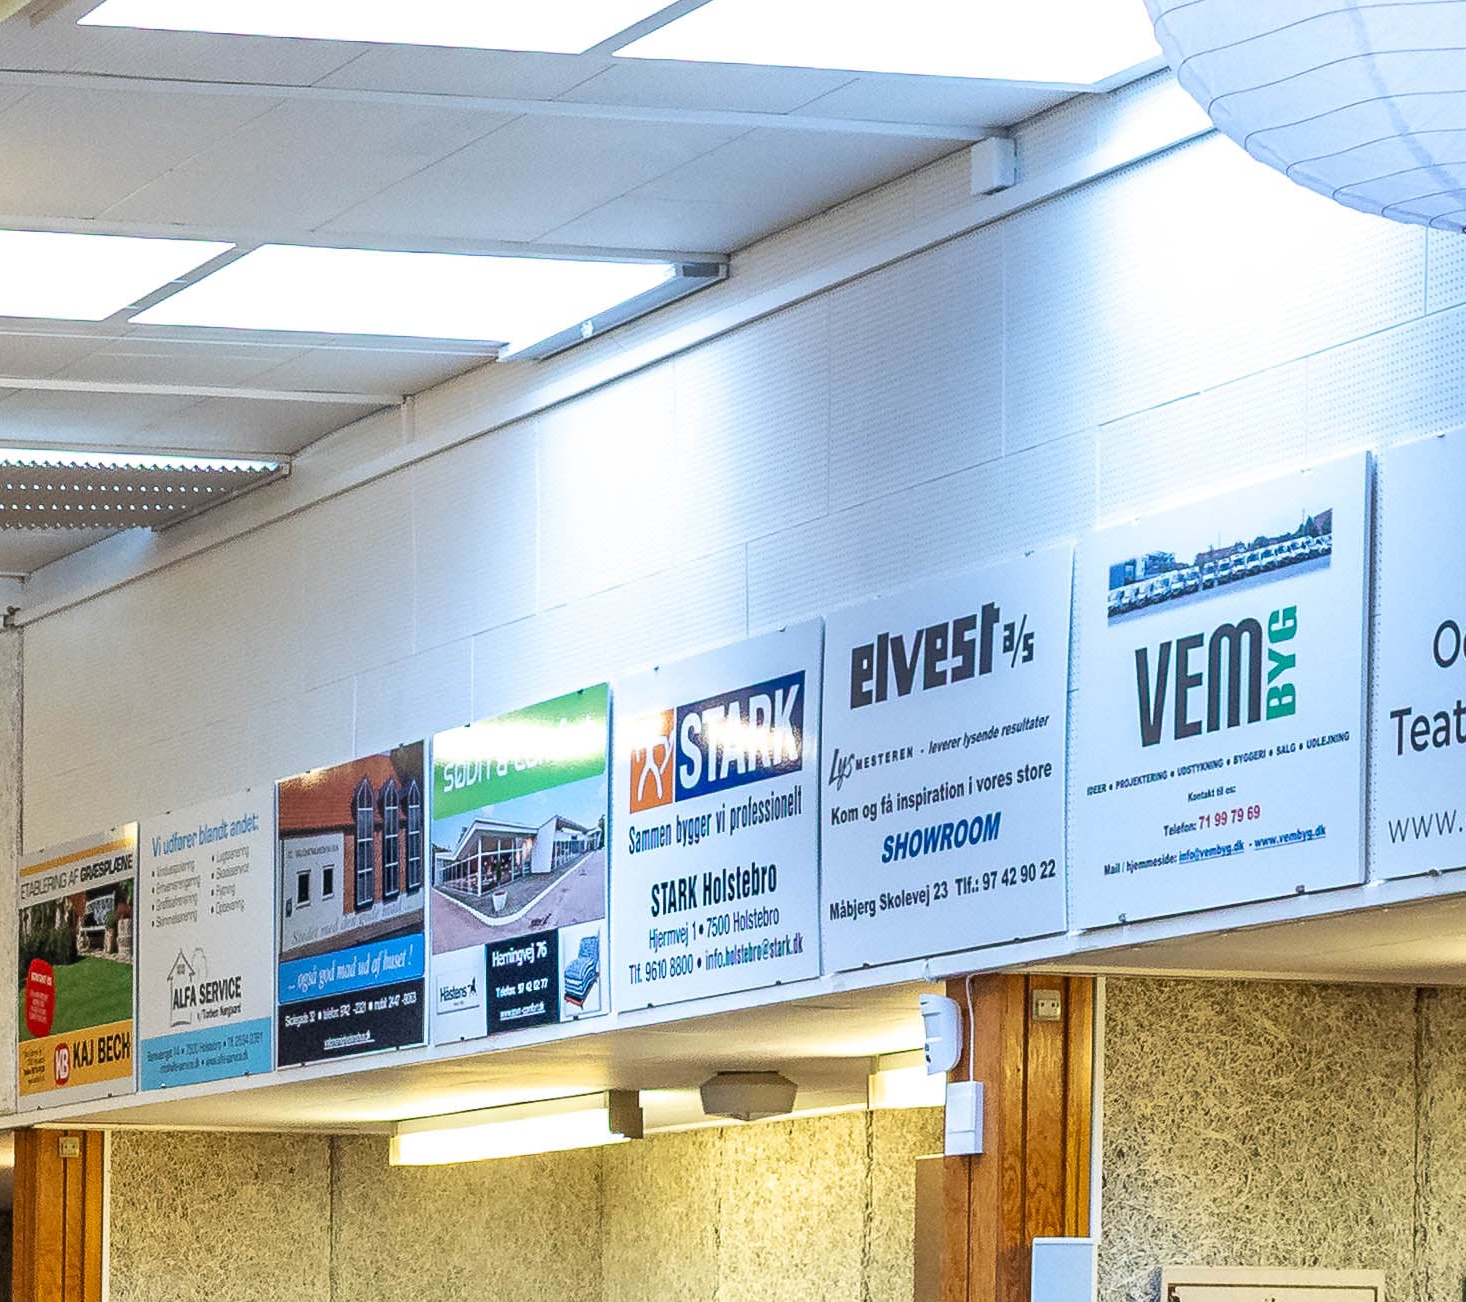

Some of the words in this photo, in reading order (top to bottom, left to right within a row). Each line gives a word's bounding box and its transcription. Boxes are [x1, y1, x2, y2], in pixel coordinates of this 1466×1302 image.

[850, 602, 1000, 709] elvest
[1002, 614, 1035, 668] a/s
[1266, 605, 1298, 720] BYG
[1135, 617, 1263, 747] VEM
[679, 684, 800, 790] STARK
[928, 736, 961, 755] leverer
[963, 726, 1000, 749] lysende
[1001, 715, 1049, 737] resultater
[1087, 783, 1107, 796] IDEER
[1115, 770, 1168, 790] PROJEKTERING
[1177, 758, 1224, 777] UDSTYKNING
[1233, 749, 1266, 765] BYGGERI
[1276, 742, 1296, 756] SALG
[1306, 731, 1350, 749] UDLEJNING
[629, 824, 671, 855] Sammen
[676, 811, 712, 847] bygger
[716, 803, 725, 833] vi
[730, 785, 802, 835] professionelt
[831, 807, 858, 826] Kom
[862, 803, 877, 821] og
[881, 793, 893, 815] få
[896, 782, 965, 812] inspiration
[976, 772, 1013, 793] vores
[1016, 762, 1053, 784] store
[1188, 789, 1215, 802] Kontakt
[152, 836, 161, 857] Vi
[198, 819, 228, 845] blandt
[881, 811, 1002, 864] SHOWROOM
[1163, 822, 1197, 837] Telefon:
[1198, 814, 1211, 830] 71
[1215, 811, 1228, 826] 99
[1231, 808, 1244, 823] 79
[1247, 805, 1261, 820] 69
[1104, 862, 1121, 876] Mail
[1126, 853, 1178, 874] hjemmeside:
[1254, 824, 1326, 851] www.vembyg.dk
[21, 872, 67, 899] ETABLERING
[68, 869, 79, 887] AF
[651, 874, 697, 917] STARK
[703, 862, 777, 906] Holstebro
[829, 900, 876, 921] Måbjerg
[879, 884, 930, 911] Skolevej
[933, 881, 948, 900] 23
[955, 876, 979, 897] Tlf.:
[982, 870, 998, 891] 97
[1001, 866, 1017, 887] 42
[1020, 863, 1036, 883] 90
[1040, 859, 1056, 880] 22
[536, 941, 548, 958] 76
[649, 922, 689, 953] Hjermvej
[706, 914, 730, 938] 7500
[733, 906, 779, 932] Holstebro
[297, 965, 318, 992] også
[318, 960, 335, 990] god
[337, 955, 357, 979] mad
[358, 952, 370, 975] ud
[371, 950, 383, 979] af
[383, 949, 406, 970] huset
[629, 963, 642, 984] Tlf.
[645, 958, 667, 982] 9610
[670, 954, 694, 978] 8800
[706, 932, 803, 970] info.holstebro@stark.dk
[173, 985, 197, 1010] ALFA
[199, 976, 242, 1004] SERVICE
[56, 1048, 69, 1080] KB
[72, 1040, 94, 1069] KAJ
[98, 1032, 130, 1063] BECH
